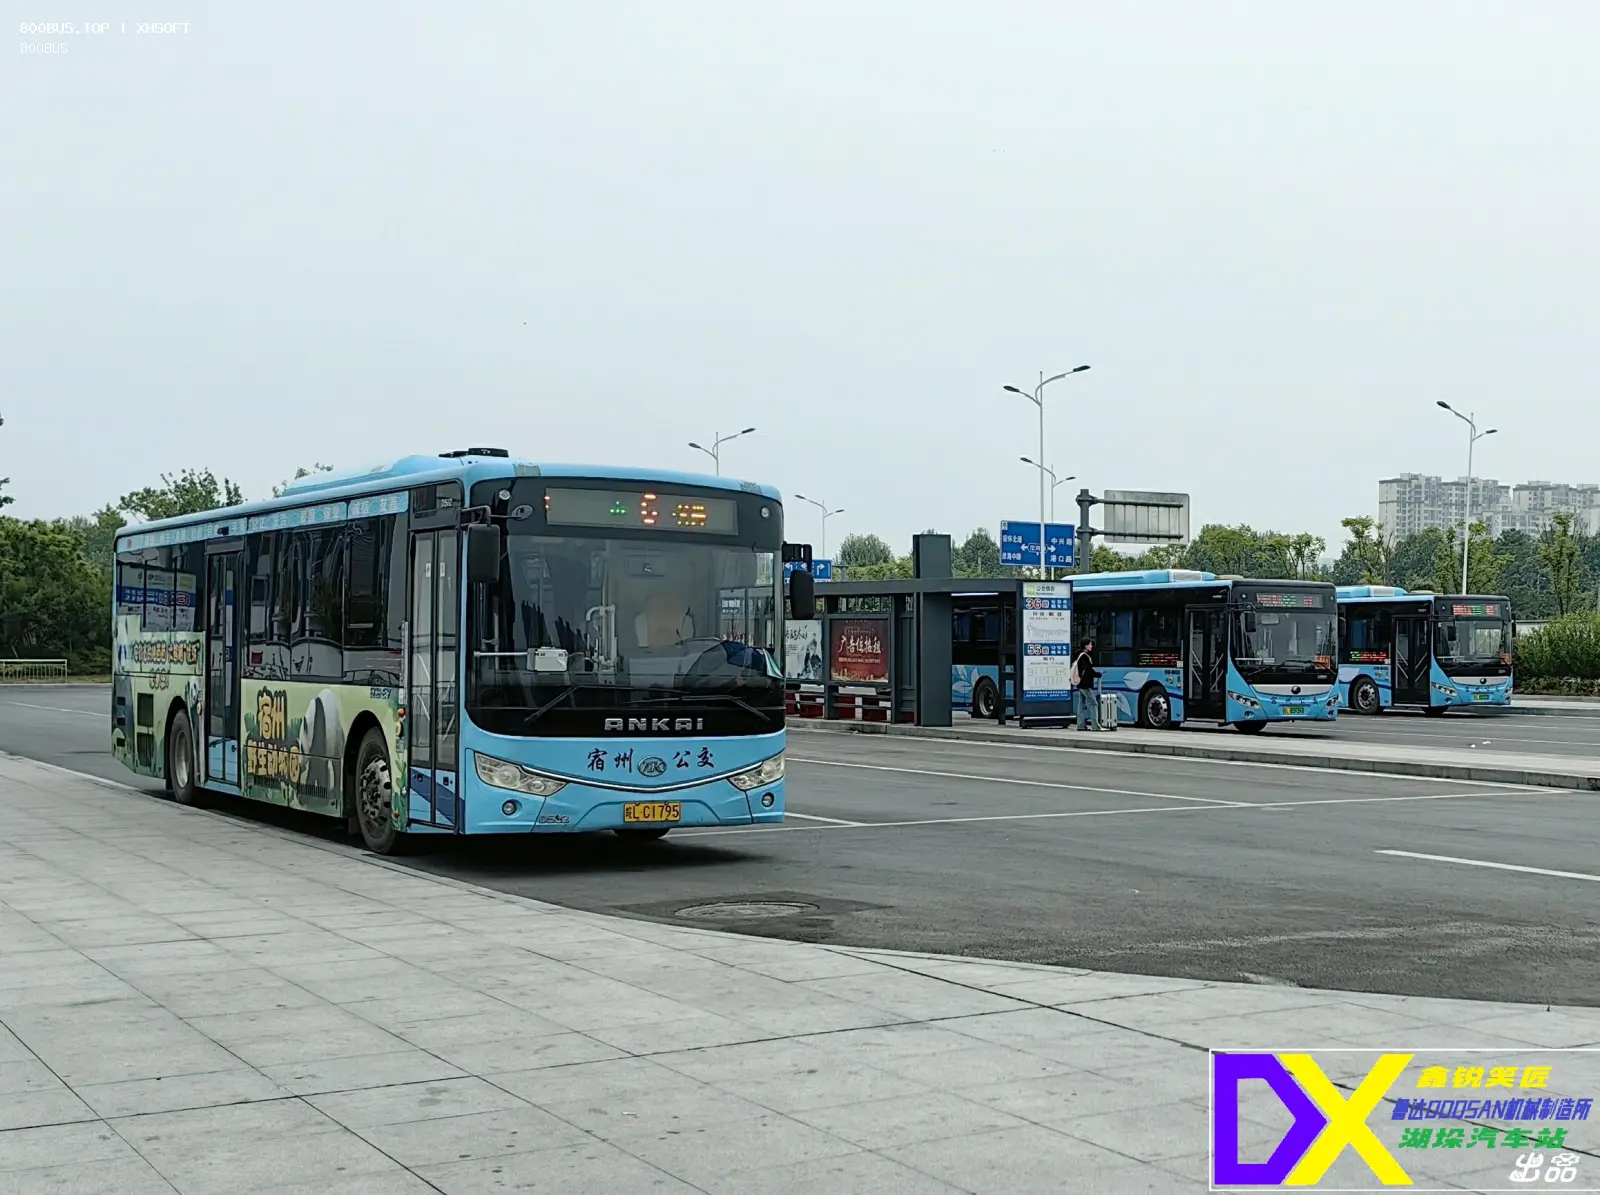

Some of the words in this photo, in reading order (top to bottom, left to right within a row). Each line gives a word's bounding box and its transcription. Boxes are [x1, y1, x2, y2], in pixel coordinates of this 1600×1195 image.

[257, 688, 286, 741] 宿州
[604, 717, 704, 731] ANKAI
[587, 748, 634, 773] 宿州
[672, 746, 715, 769] 公交
